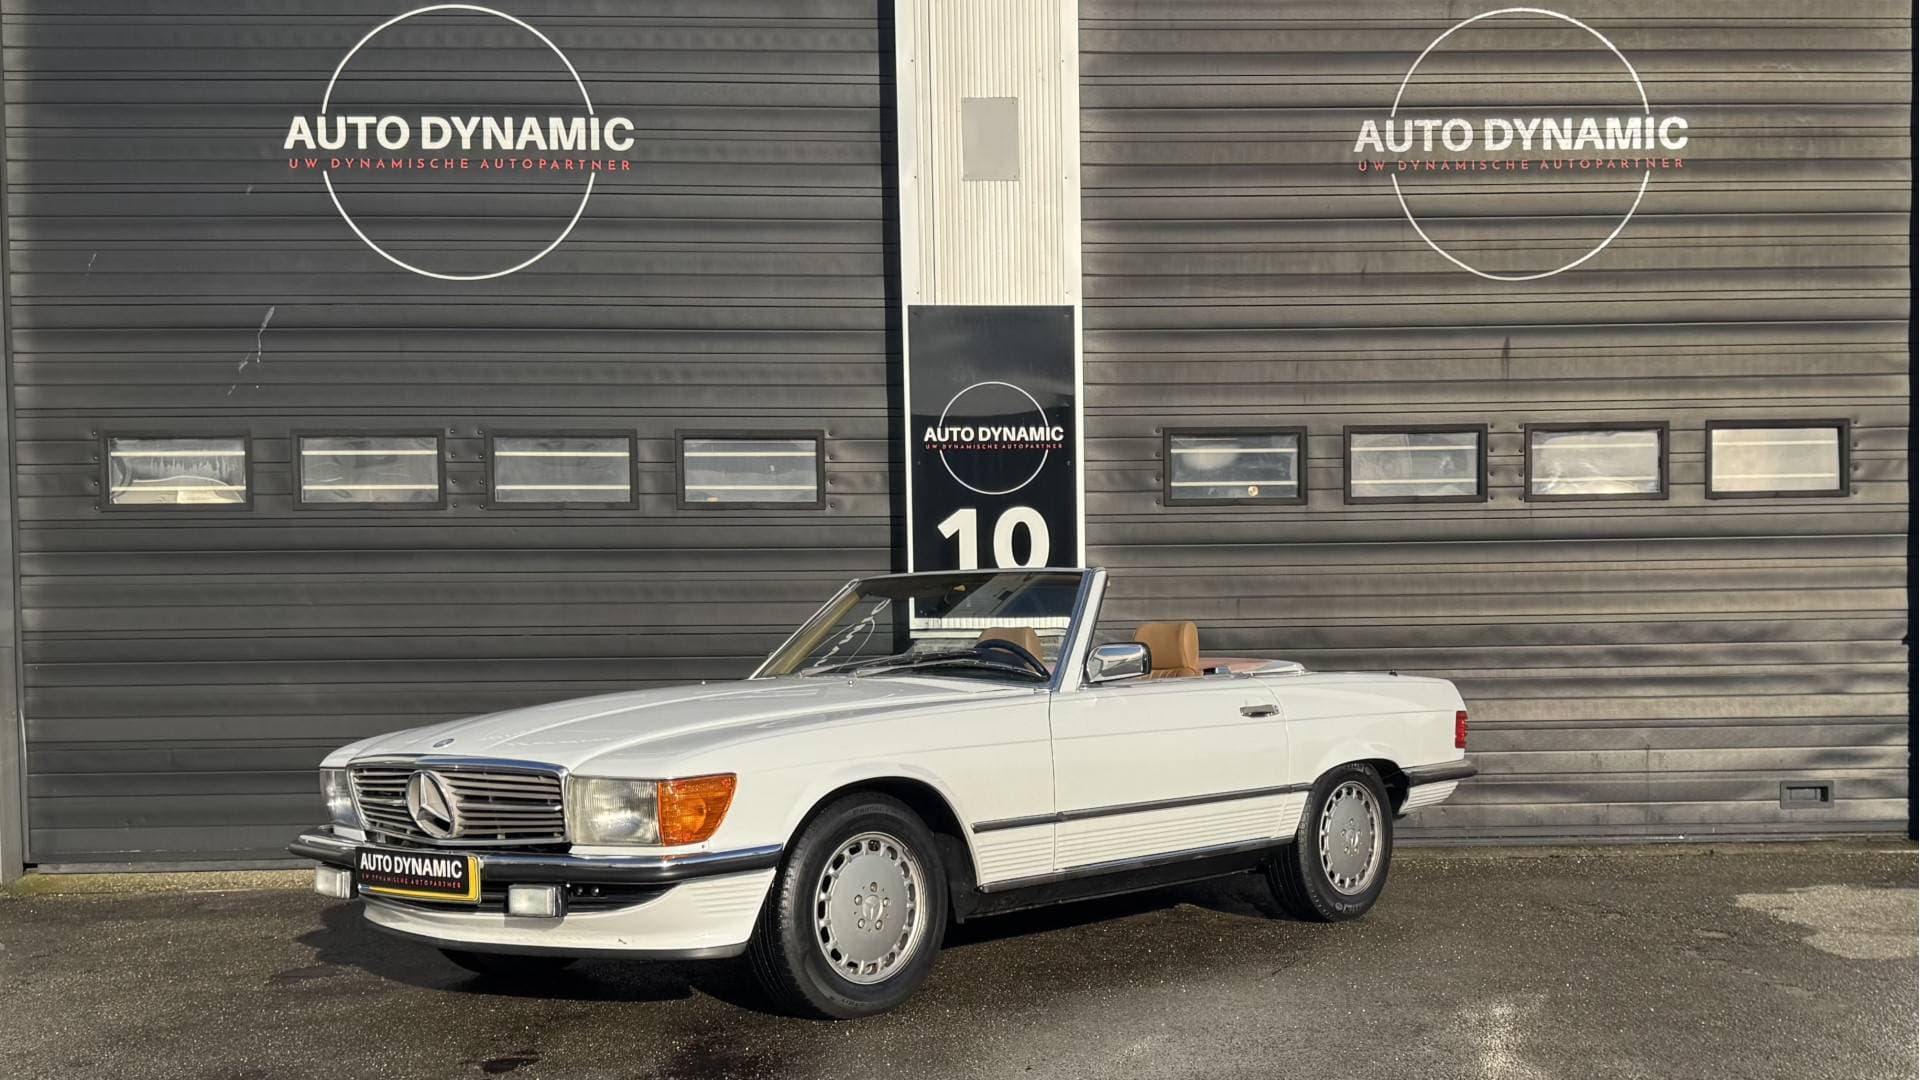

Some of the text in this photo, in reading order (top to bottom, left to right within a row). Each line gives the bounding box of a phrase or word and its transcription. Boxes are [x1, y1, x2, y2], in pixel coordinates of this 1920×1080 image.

[284, 116, 635, 151] AUTO DYNAMIC
[1354, 116, 1689, 152] AUTO DYNAMIC
[288, 158, 631, 171] UW DYNAMISCHE AUTOPARTNER
[1358, 157, 1684, 172] UW DYNAMISCHE AUTOPARTNER
[924, 426, 1064, 442] AUTO DYNAMIC
[937, 506, 1050, 571] 10
[360, 853, 462, 878] AUTO DYNAMIC
